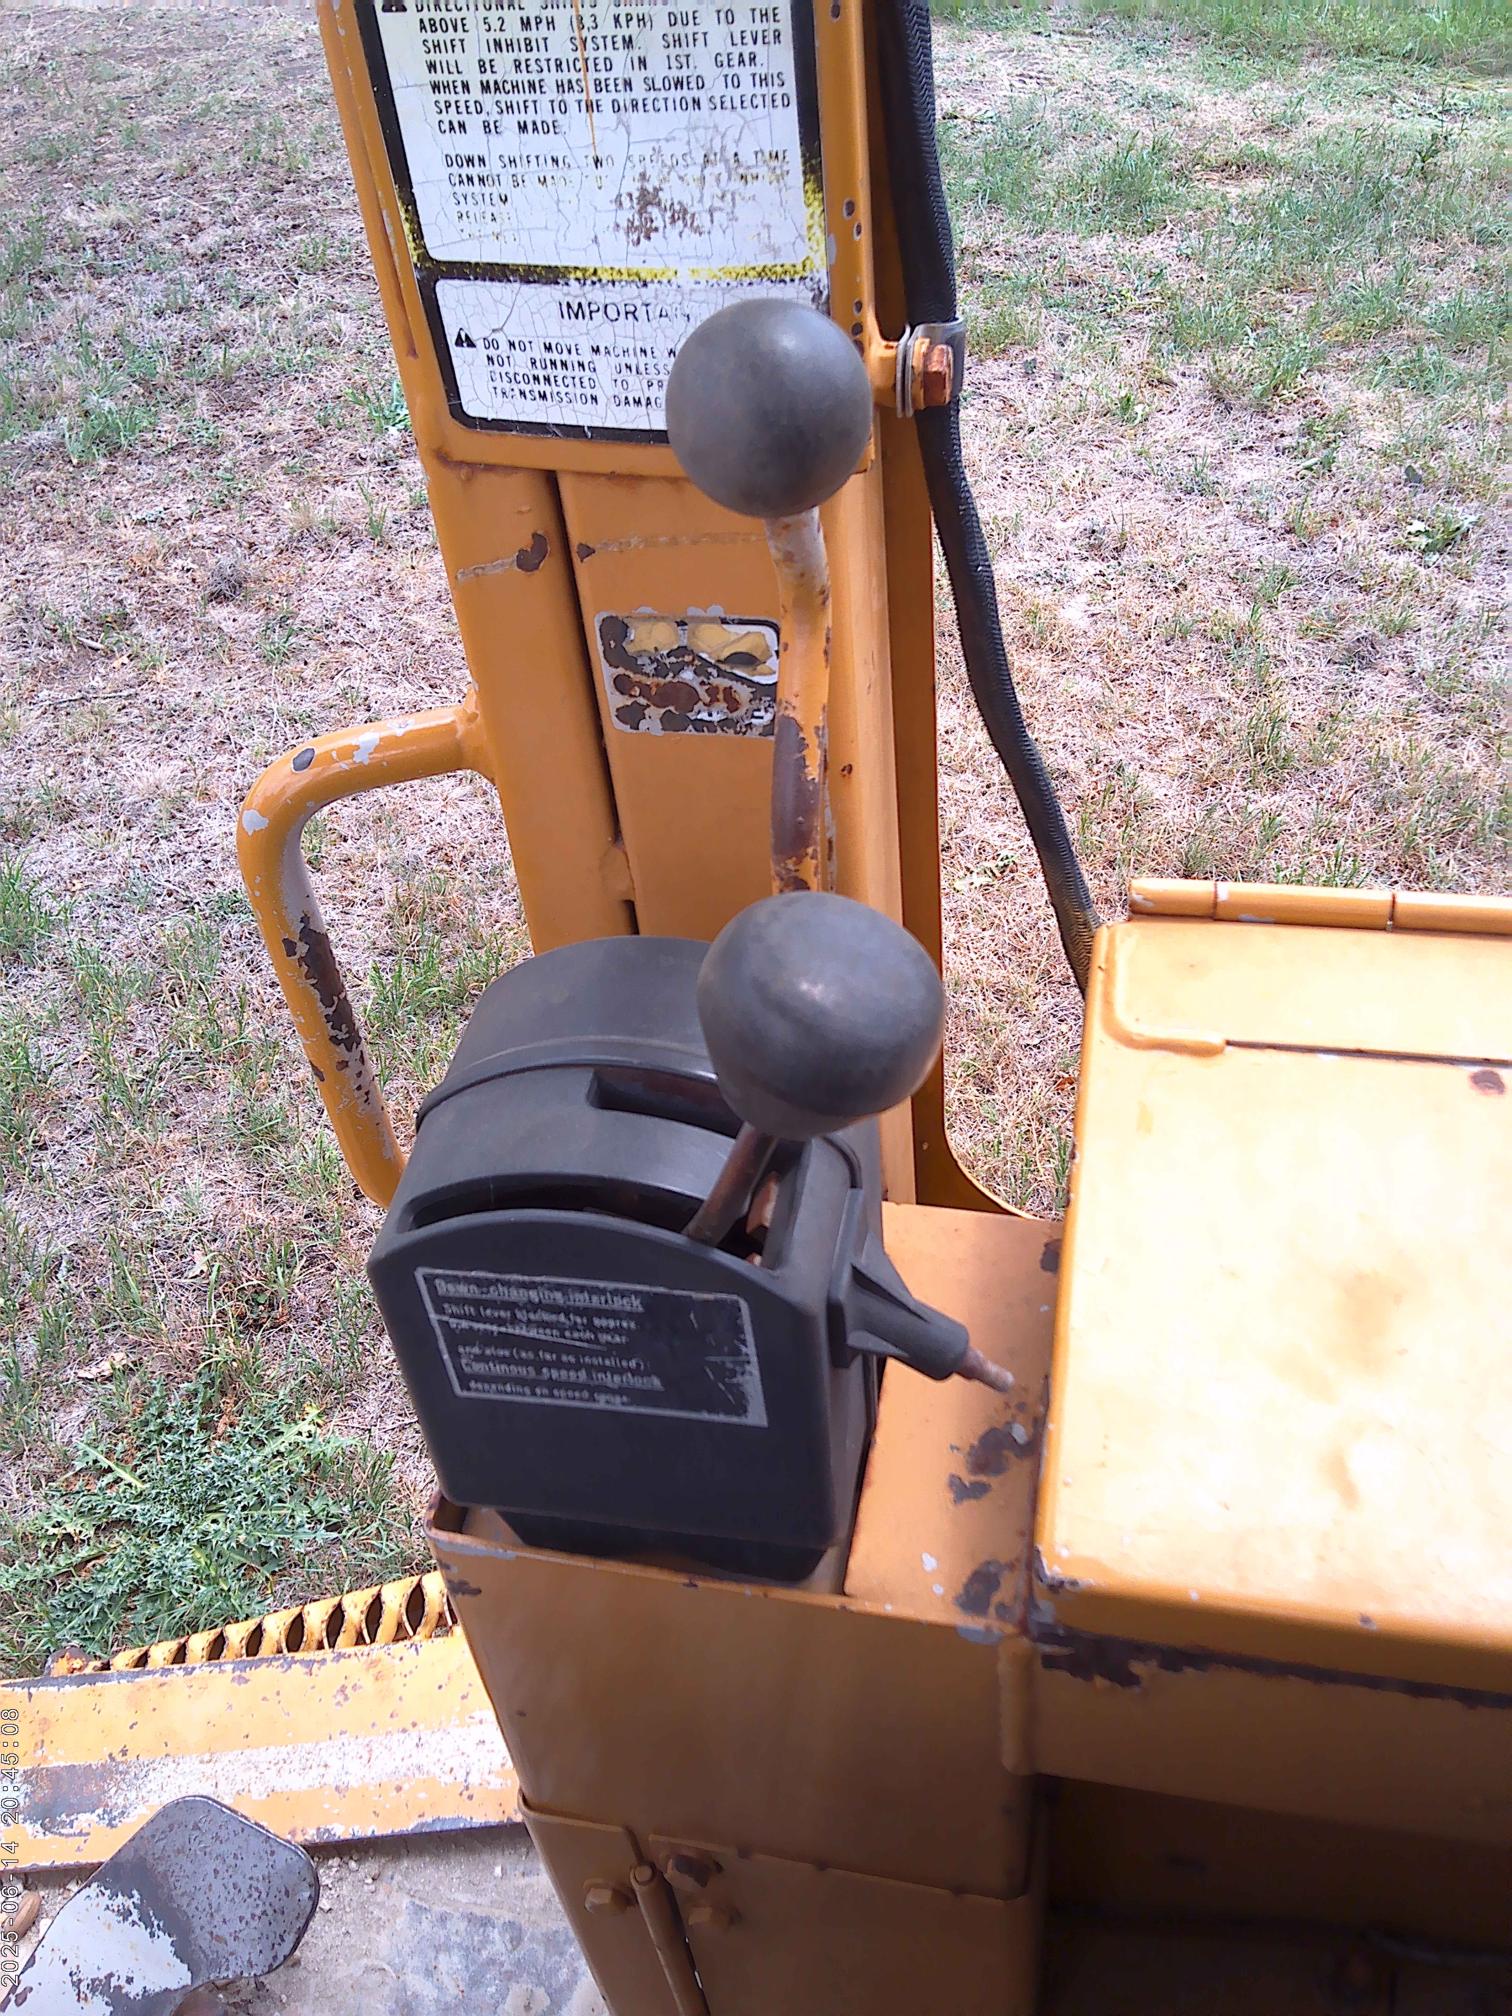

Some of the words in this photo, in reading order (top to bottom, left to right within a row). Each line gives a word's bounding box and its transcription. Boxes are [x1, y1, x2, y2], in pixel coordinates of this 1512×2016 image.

[419, 16, 469, 33] ABOVE
[484, 16, 505, 32] 5.2
[520, 16, 556, 32] MPH
[614, 12, 653, 31] KPH)
[668, 10, 700, 28] DUE
[715, 9, 735, 25] TO
[750, 7, 781, 24] THE
[422, 39, 465, 54] SHIFT
[487, 37, 549, 54] INHIBIT
[570, 34, 642, 52] SYSTEM.
[662, 31, 708, 49] SHIFT
[730, 29, 781, 47] LEVER
[425, 59, 463, 75] WILL
[478, 59, 498, 74] BE
[514, 56, 613, 74] RESTRICTED
[631, 55, 647, 71] IN
[667, 54, 698, 70] 1ST.
[715, 51, 764, 69] GEAR.
[429, 80, 471, 95] WHEN
[480, 79, 546, 95] MACHINE
[556, 78, 584, 94] HAS
[594, 77, 632, 93] BEEN
[644, 76, 705, 91] SLOWED
[722, 74, 740, 90] TO
[751, 71, 785, 88] THIS
[434, 100, 490, 116] SPEED,
[496, 99, 539, 115] SHIFT
[550, 100, 568, 115] TO
[577, 99, 604, 114] THE
[611, 97, 701, 114] DIRECTION
[709, 93, 791, 111] SELECTED
[438, 120, 467, 135] CAN
[483, 120, 500, 135] BE
[518, 120, 567, 135] MADE.
[445, 154, 487, 169] DOWN
[499, 154, 572, 169] SHIFTING
[753, 149, 789, 167] TME
[449, 173, 502, 188] CANNOT
[453, 191, 508, 206] SYSTEM
[558, 301, 691, 323] IMPORTA
[483, 338, 499, 351] DO
[508, 338, 533, 352] NOT
[543, 341, 580, 356] MOVE
[591, 344, 657, 360] MACHINE
[486, 354, 512, 367] NOT
[530, 357, 597, 373] RUNNING
[615, 362, 671, 377] UNLESS
[489, 371, 597, 390] DISCONNECTED
[612, 378, 629, 391] TO
[493, 386, 599, 406] TRANSMISSION
[613, 394, 662, 409] DAMAG
[566, 1287, 641, 1310] interlock
[443, 1303, 476, 1317] Shift
